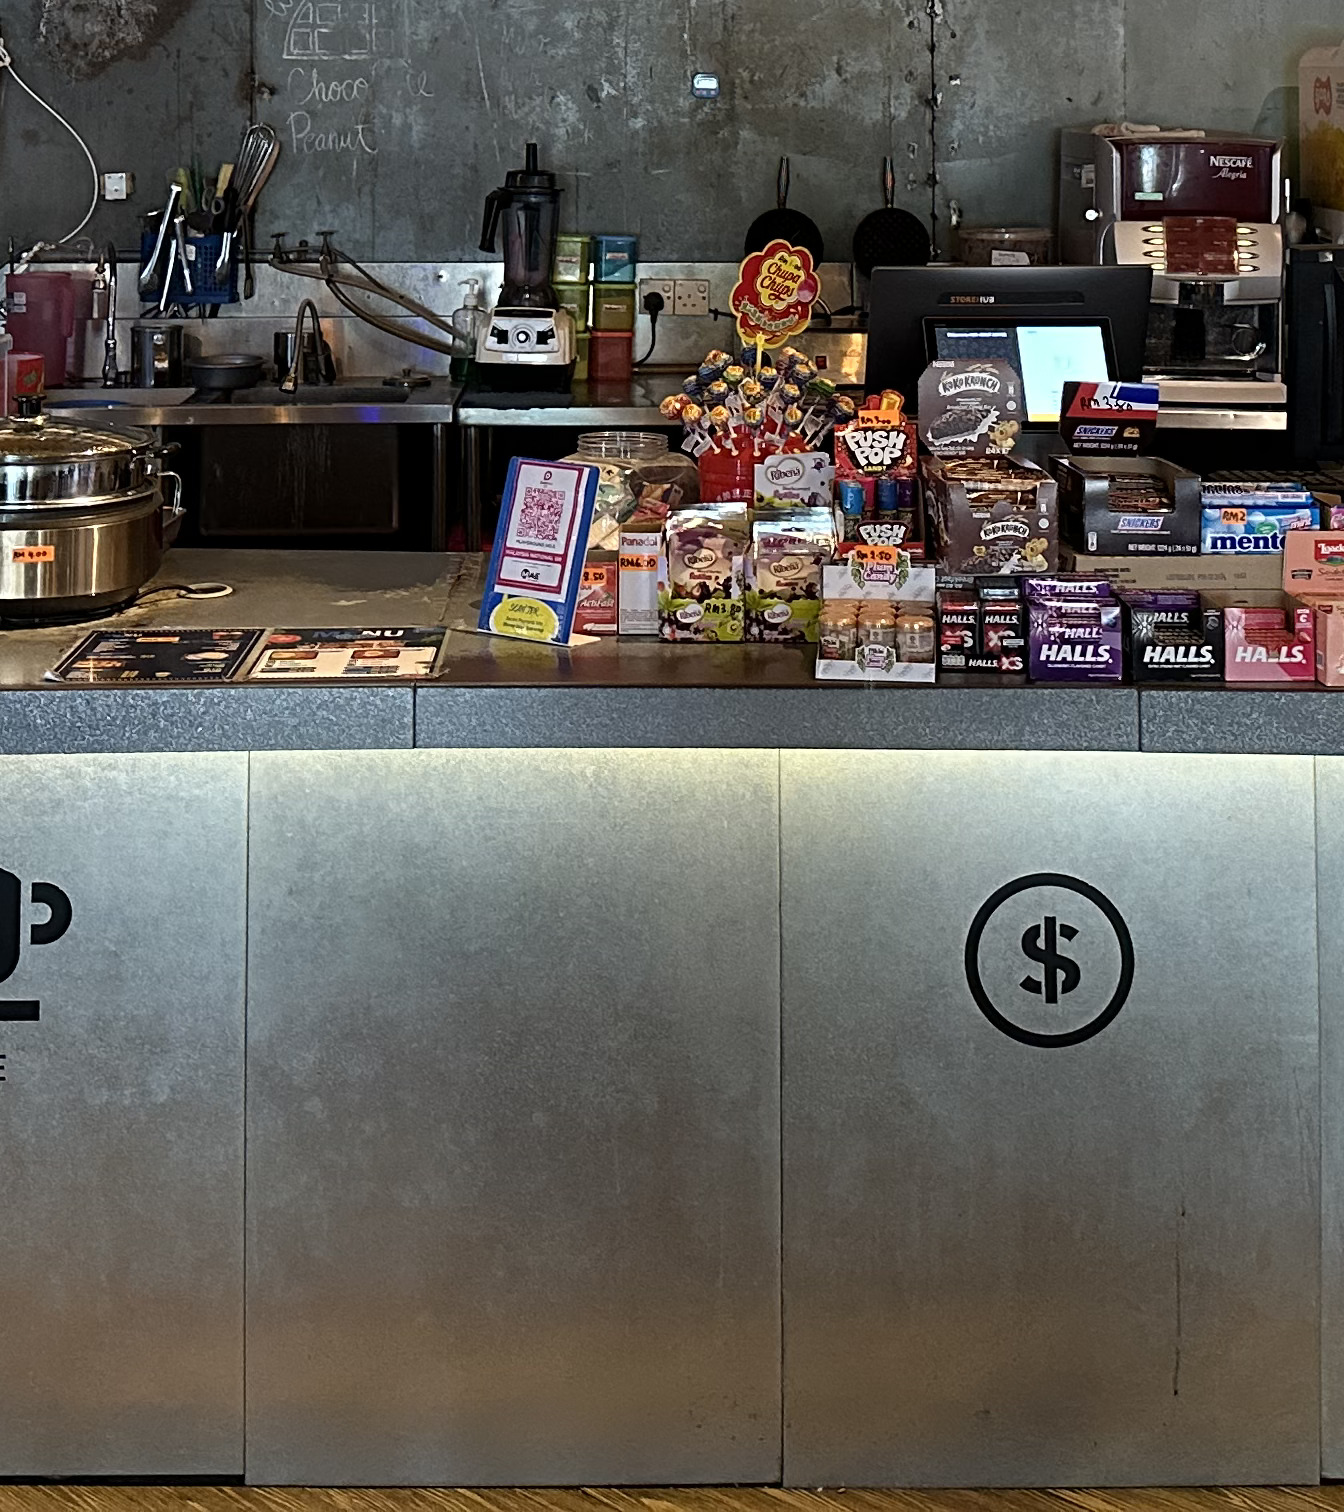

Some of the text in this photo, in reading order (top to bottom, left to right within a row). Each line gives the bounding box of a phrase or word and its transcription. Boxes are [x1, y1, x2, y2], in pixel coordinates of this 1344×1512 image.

[288, 110, 378, 155] Peanut
[1212, 168, 1247, 181] Alegria
[767, 262, 802, 284] Chupa
[760, 275, 796, 301] Chups
[845, 430, 907, 451] PUSH
[855, 446, 902, 466] POP
[770, 464, 802, 482] Ribena
[859, 524, 906, 540] PUSH
[1120, 517, 1161, 530] SNICKERS
[621, 536, 658, 548] Panadol
